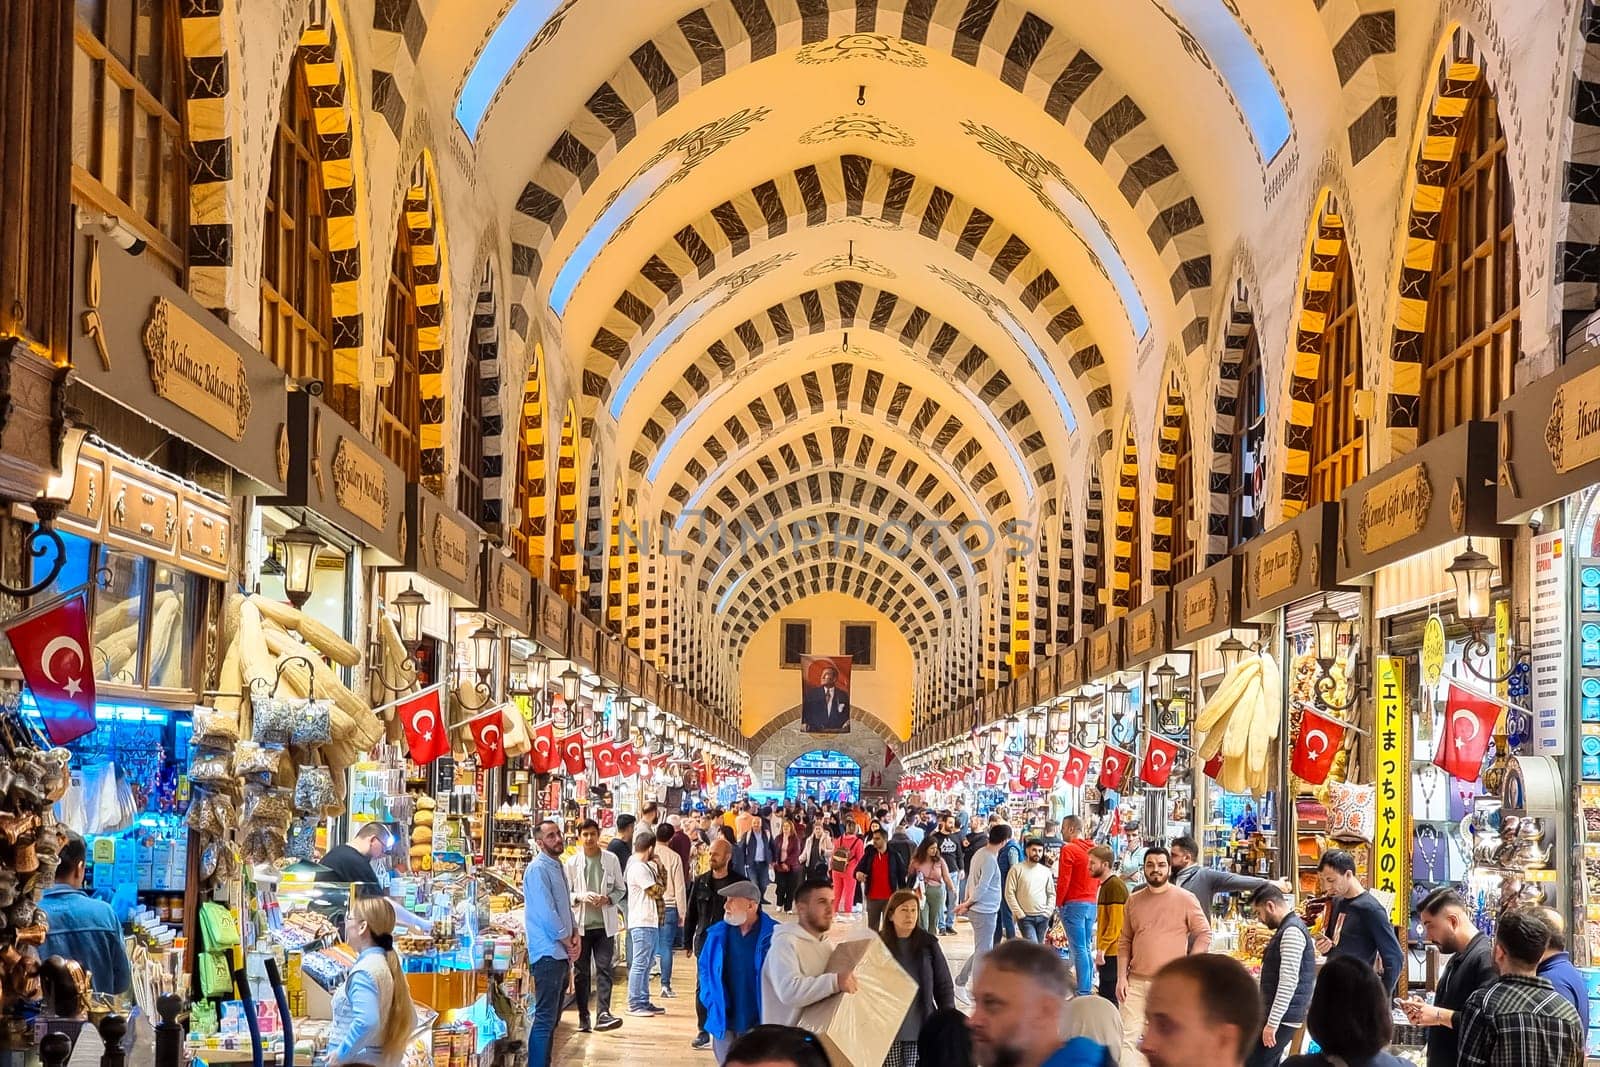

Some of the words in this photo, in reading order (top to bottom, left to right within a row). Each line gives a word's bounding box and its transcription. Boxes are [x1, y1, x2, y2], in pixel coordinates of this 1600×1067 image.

[169, 340, 203, 388] Kalmaz
[204, 363, 235, 409] Baharat
[1400, 483, 1416, 520] Shop
[1380, 683, 1397, 924] エドまっちゃんのみ
